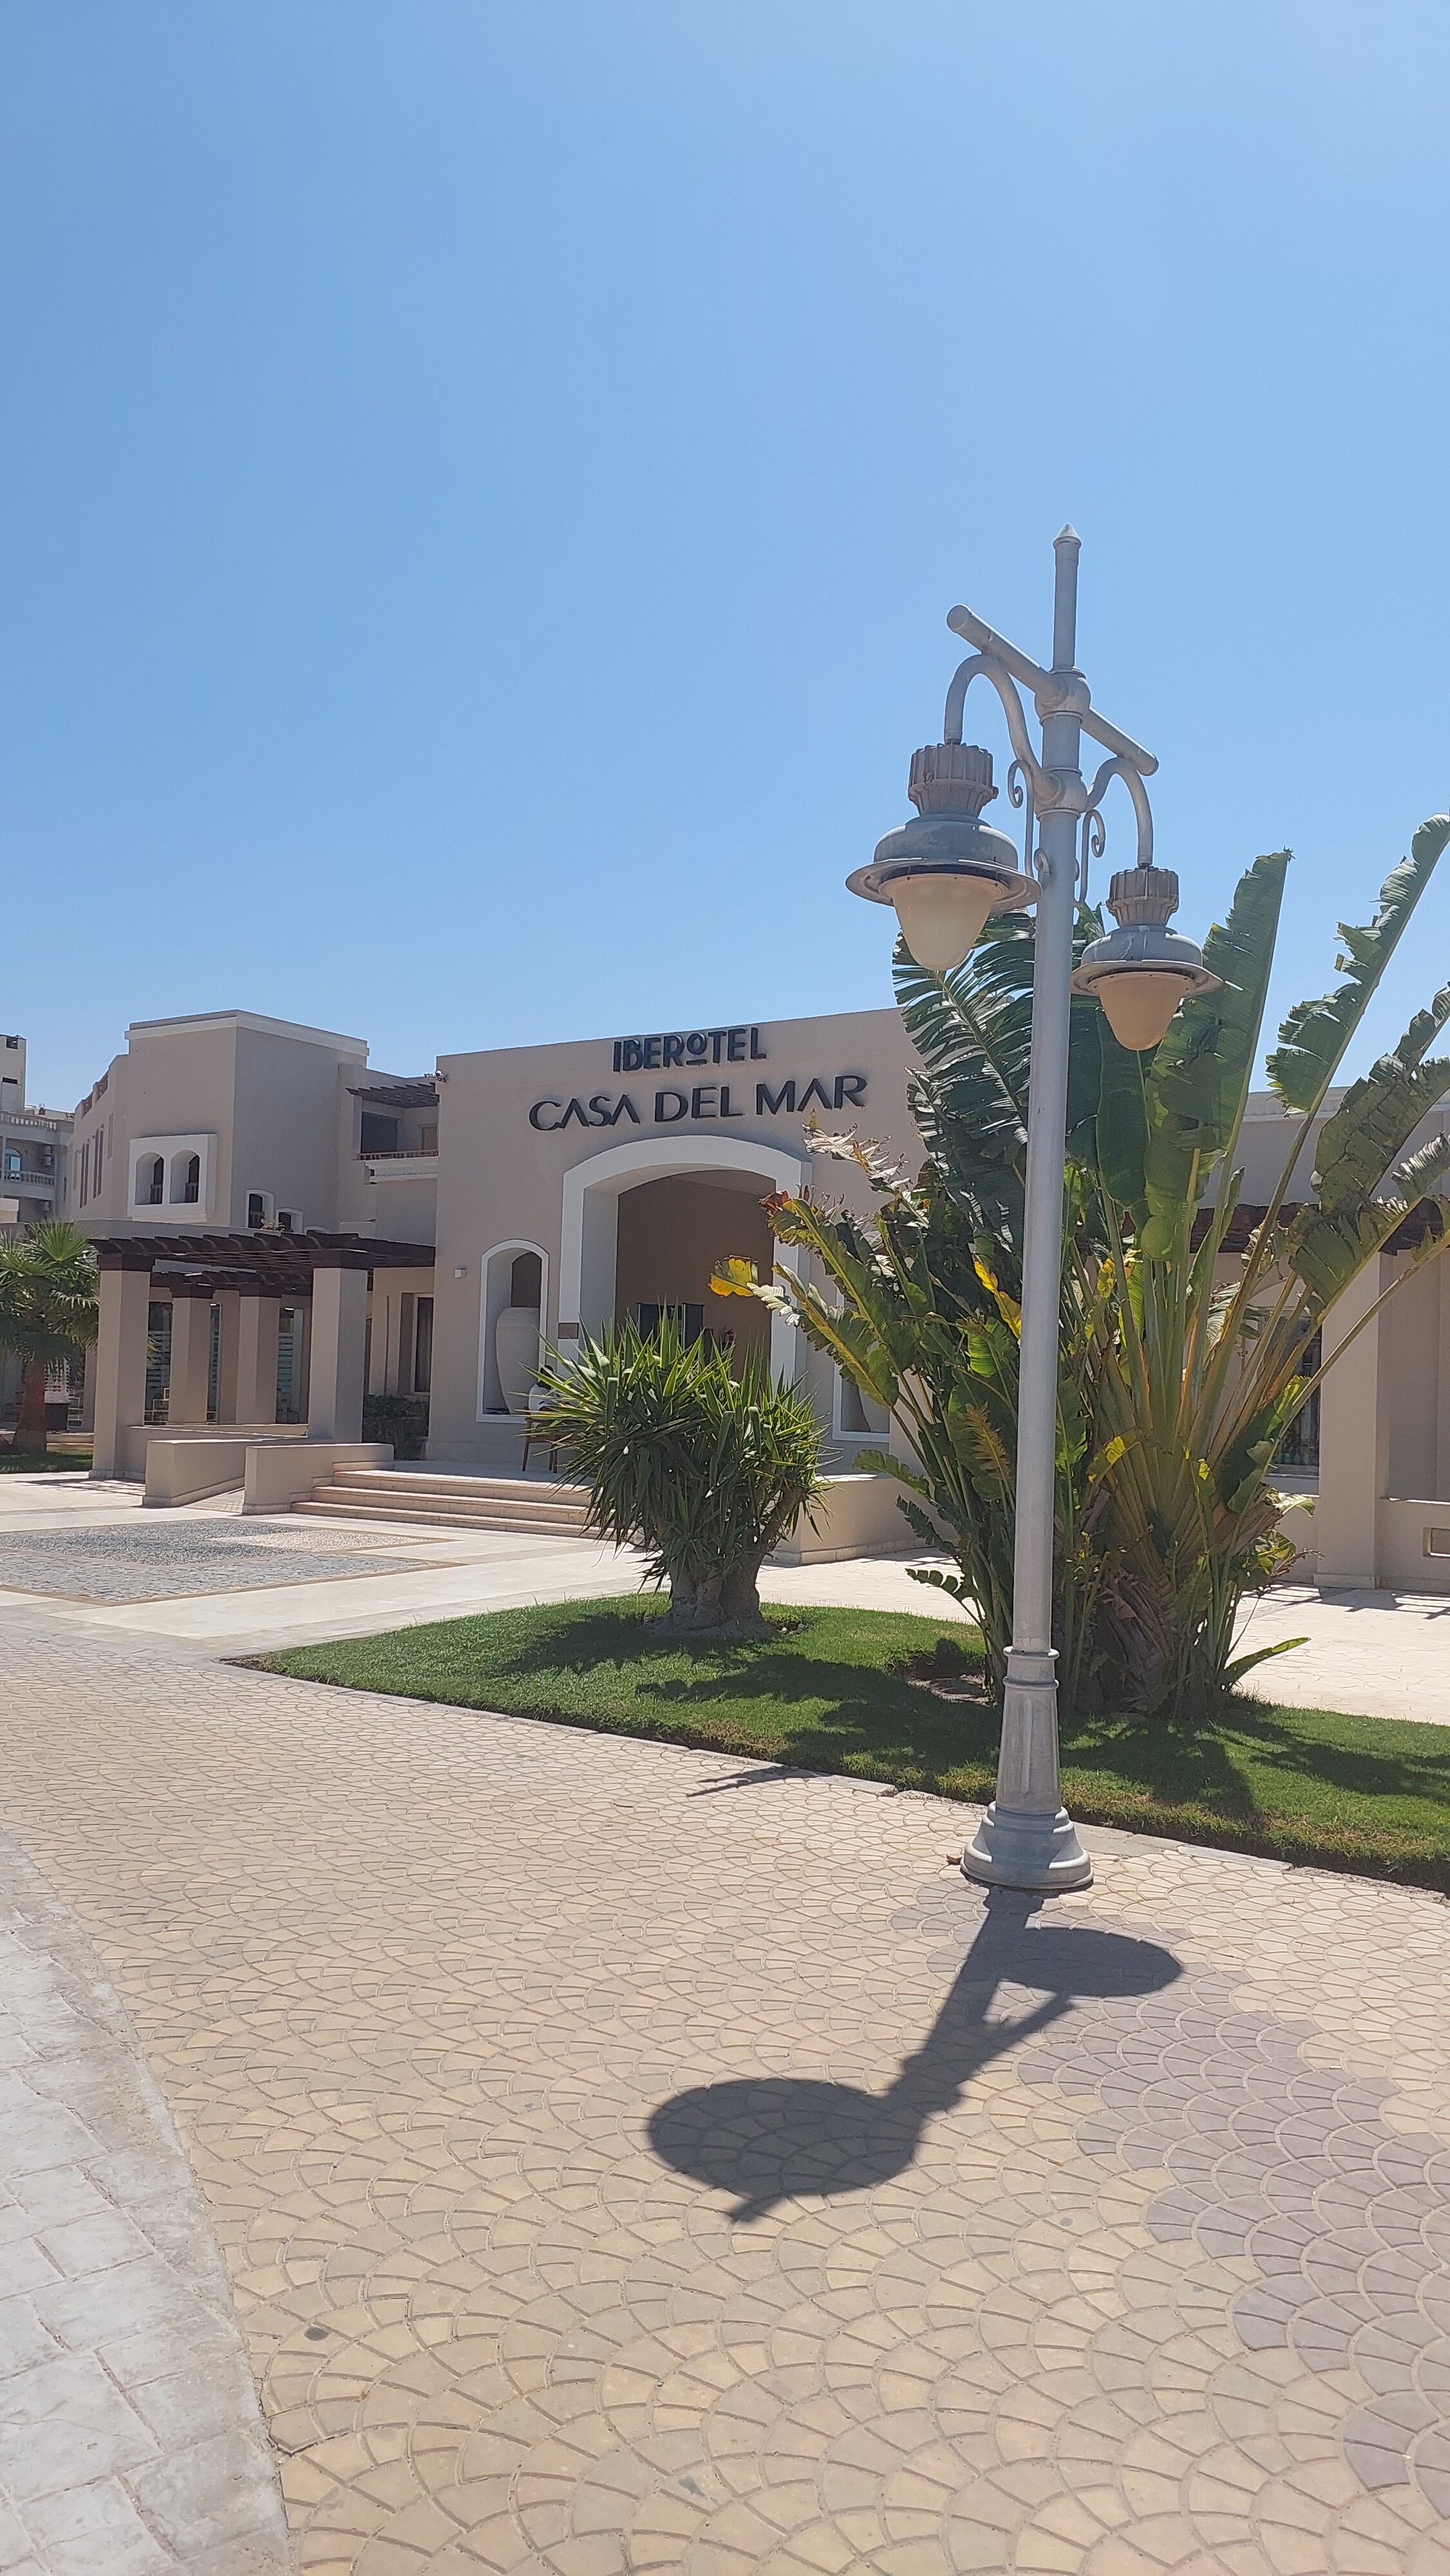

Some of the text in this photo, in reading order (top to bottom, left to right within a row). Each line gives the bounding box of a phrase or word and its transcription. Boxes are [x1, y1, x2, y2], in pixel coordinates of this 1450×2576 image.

[613, 1027, 766, 1072] IBEROTEL
[529, 1075, 867, 1130] CASA DEL MAR
